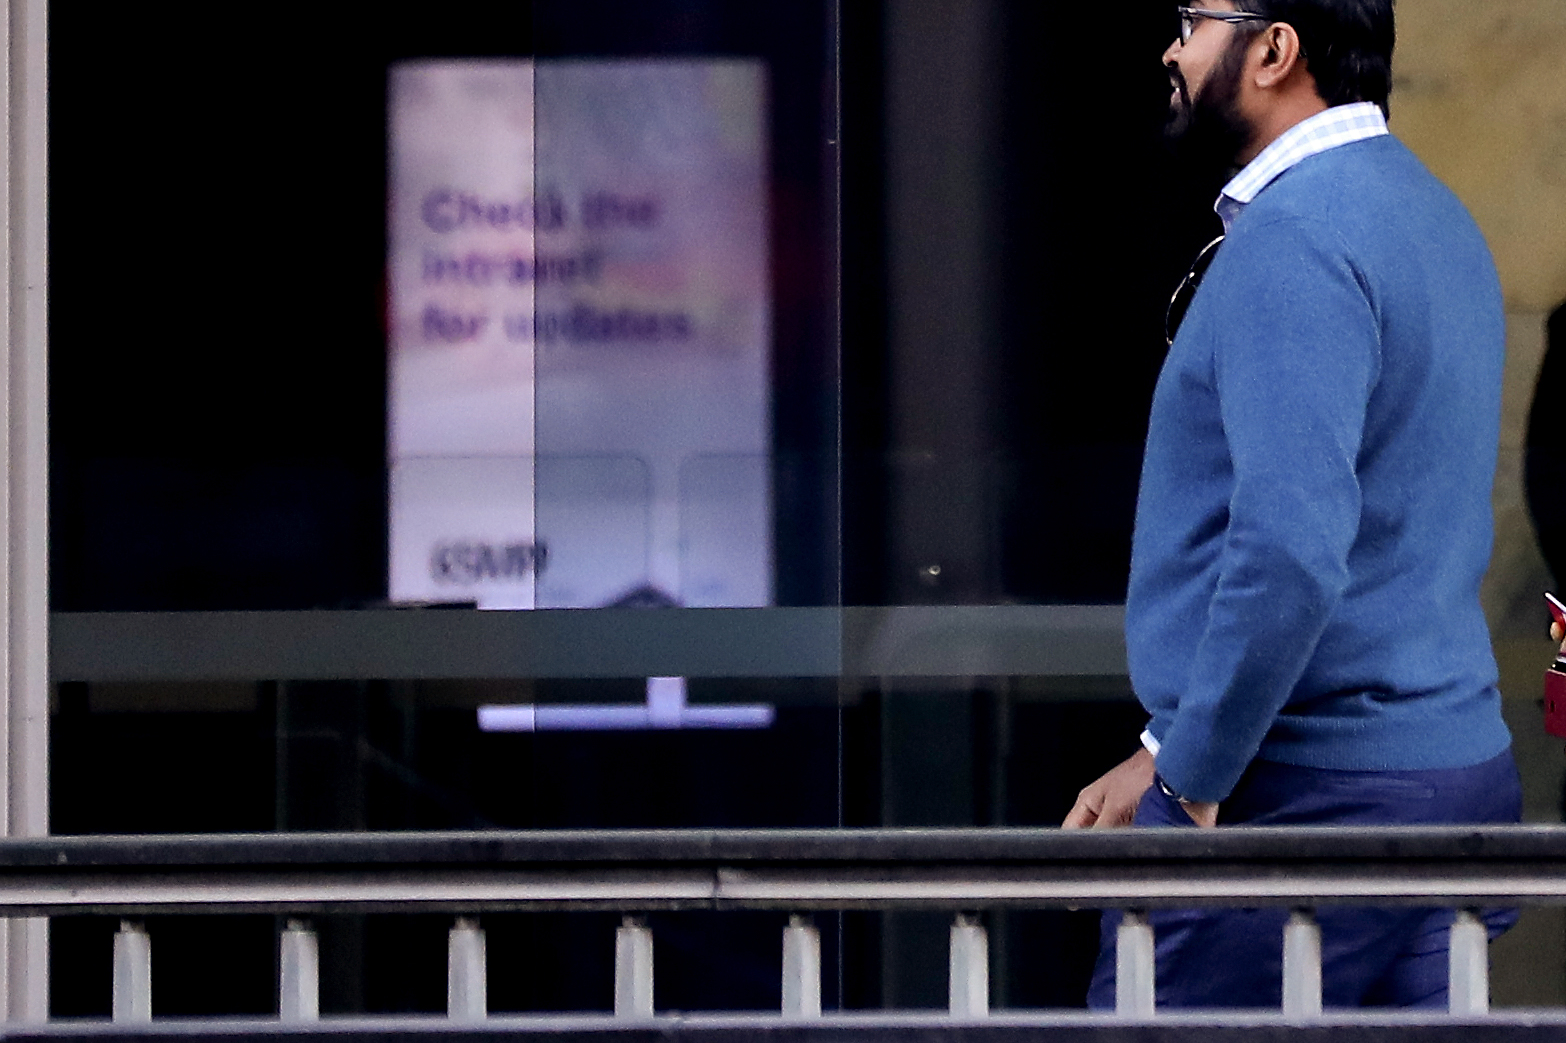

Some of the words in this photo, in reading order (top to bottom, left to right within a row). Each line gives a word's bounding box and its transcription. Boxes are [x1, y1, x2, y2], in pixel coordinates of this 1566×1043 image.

[421, 184, 566, 233] Check
[581, 186, 663, 229] the
[421, 302, 488, 344] for
